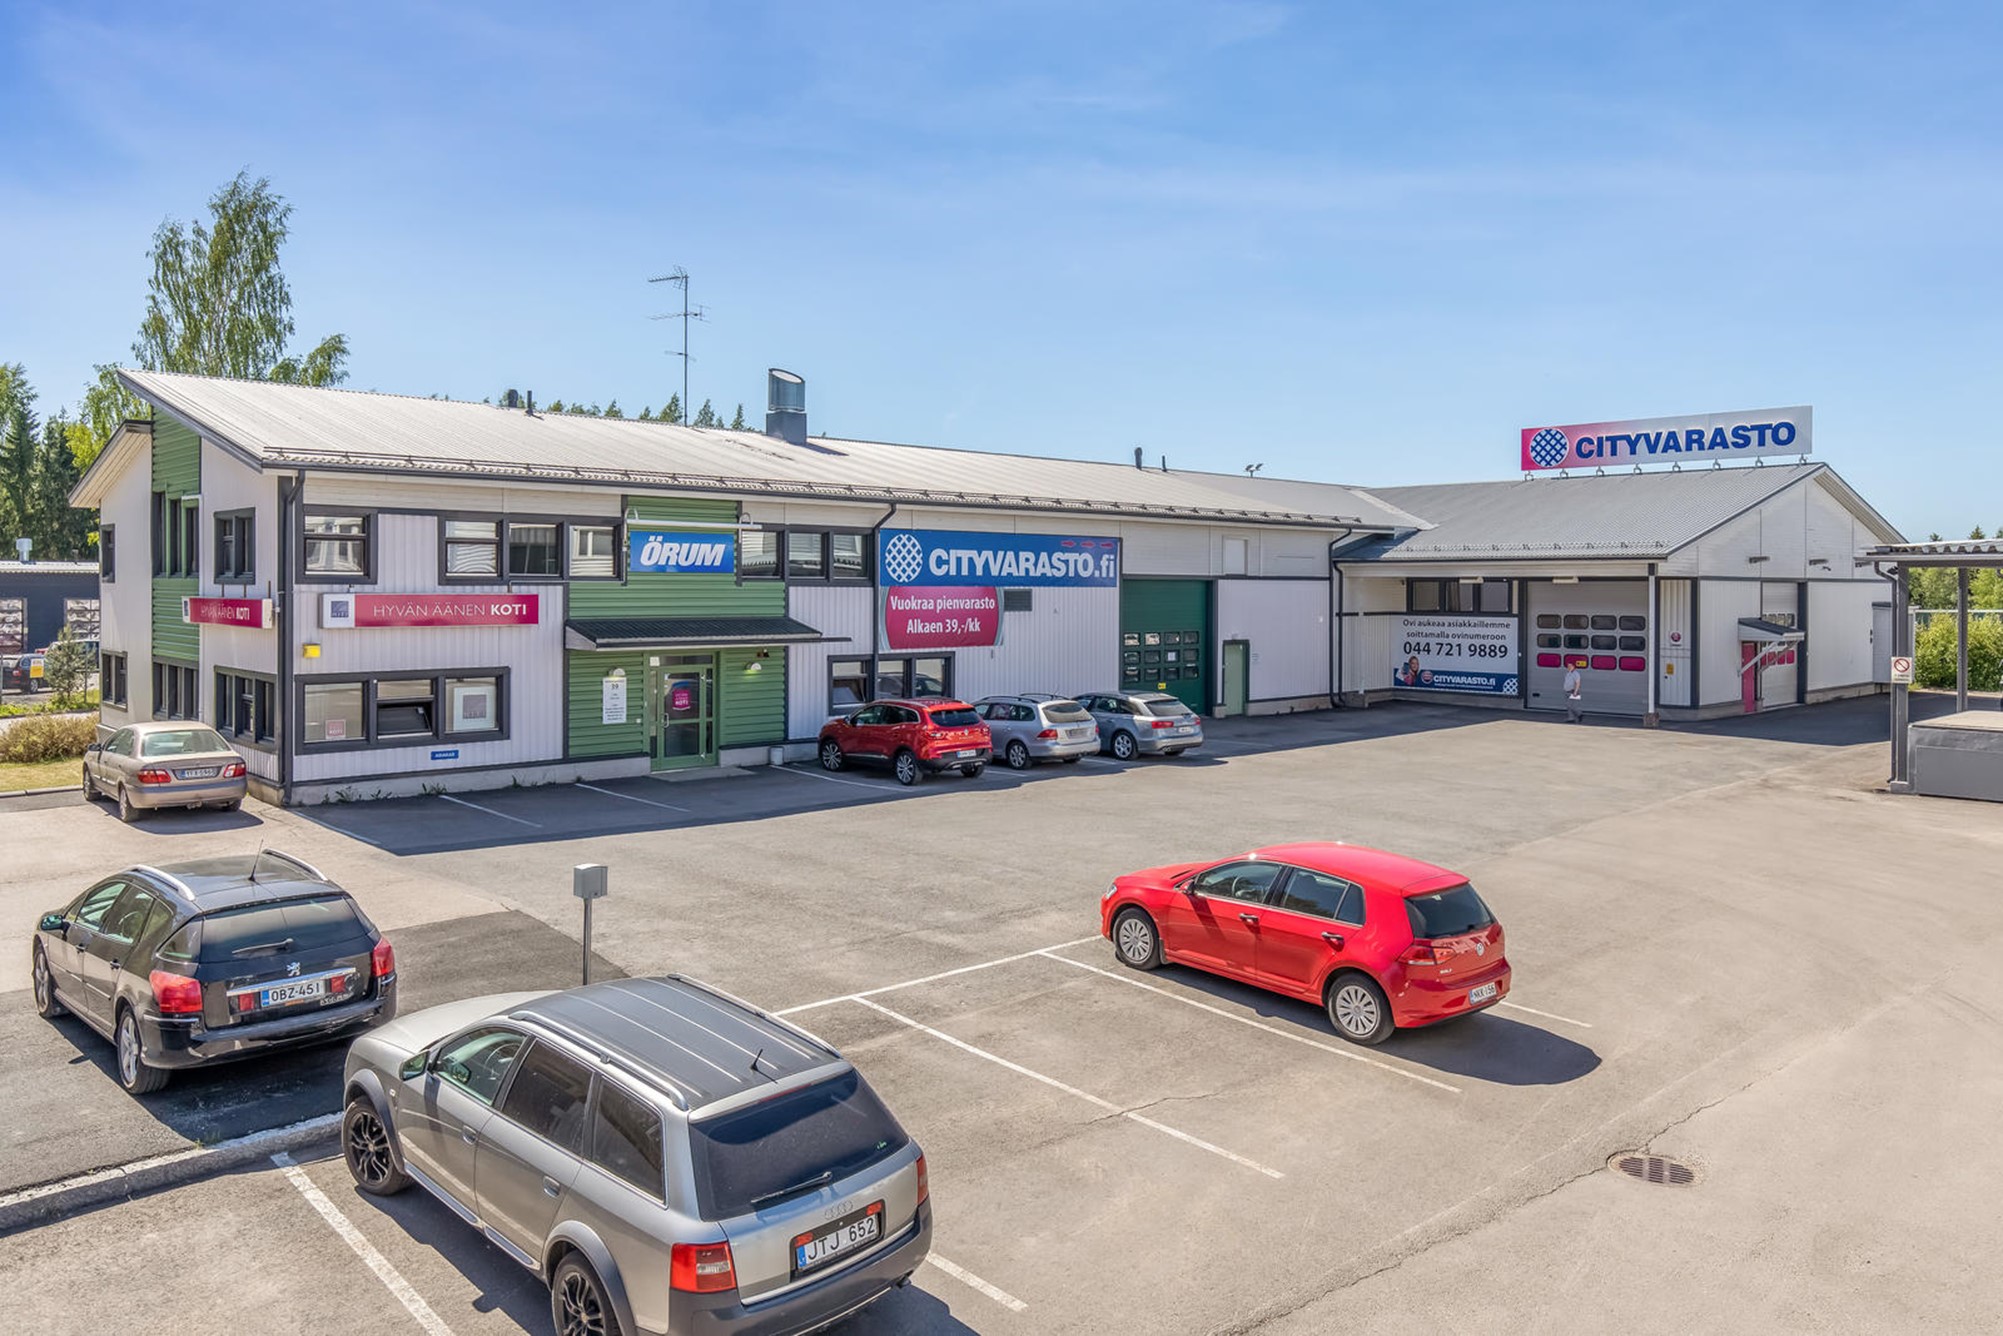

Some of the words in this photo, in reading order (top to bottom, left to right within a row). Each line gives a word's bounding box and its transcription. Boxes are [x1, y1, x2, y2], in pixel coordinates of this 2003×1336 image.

[1575, 421, 1796, 459] CITYVARASTO
[640, 535, 726, 567] ÖRUM
[928, 548, 1115, 578] CITYVARASTO.fi
[373, 602, 428, 617] HYVÄN
[432, 602, 486, 617] ÄÄNEN
[490, 603, 527, 616] KOTI
[890, 596, 934, 610] Vuokraa
[936, 596, 995, 613] pienvarasto
[906, 619, 943, 634] Alkaen
[945, 618, 981, 635] 39,-/kk
[1402, 619, 1417, 627] Ovi
[1417, 619, 1446, 628] aukeaa
[1446, 619, 1511, 629] asiakkaillemme
[1406, 630, 1450, 639] soittamalla
[1451, 631, 1506, 641] ovinumeroon
[1403, 641, 1431, 655] 044
[1435, 642, 1462, 657] 721
[1468, 643, 1508, 659] 9889
[1433, 674, 1496, 686] CITYVARASTO.fi
[271, 982, 320, 1001] OBZ-451
[808, 1232, 839, 1260] JTJ
[848, 1217, 875, 1242] 652
